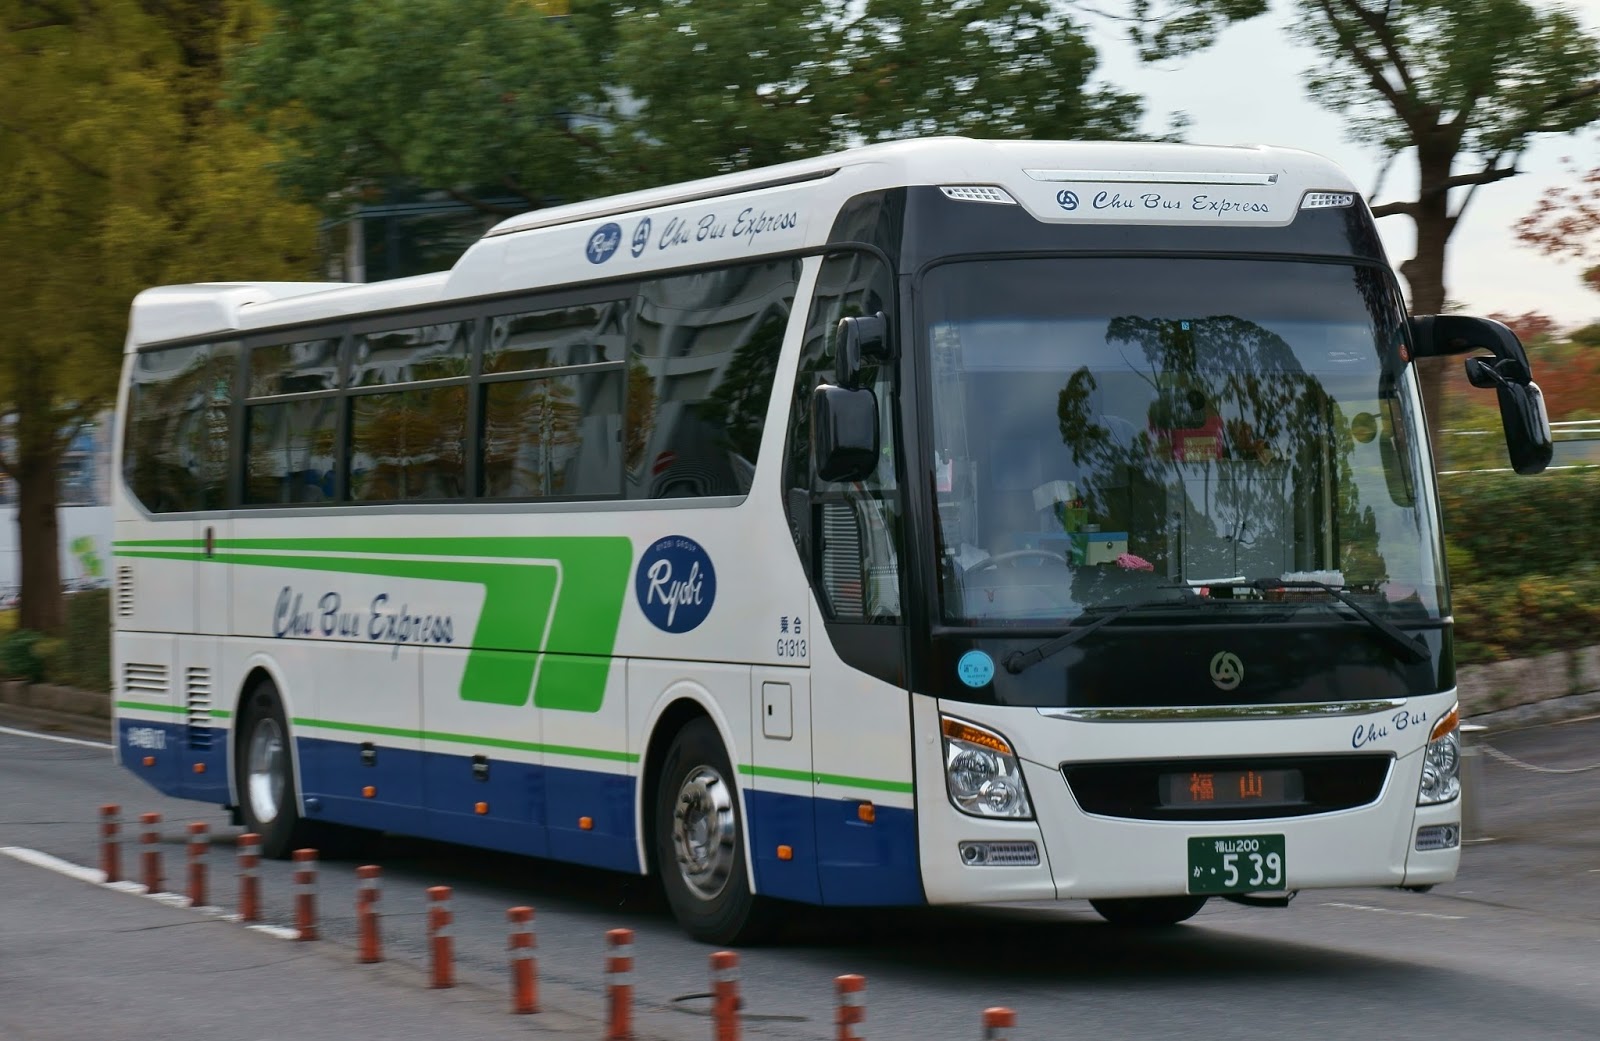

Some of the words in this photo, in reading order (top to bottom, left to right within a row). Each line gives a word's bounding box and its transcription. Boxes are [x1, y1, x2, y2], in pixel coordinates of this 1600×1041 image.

[1092, 191, 1135, 209] Chu
[1140, 193, 1182, 209] Bus
[1192, 195, 1269, 217] Express
[659, 216, 689, 250] Chu
[696, 213, 725, 242] Bus
[732, 207, 797, 247] Express
[647, 559, 703, 627] Ryobi
[273, 585, 313, 638] Chu
[318, 591, 360, 637] Bus
[367, 593, 454, 661] Express
[777, 638, 806, 657] G1313
[1352, 723, 1387, 748] Chu
[1392, 711, 1426, 730] Bus
